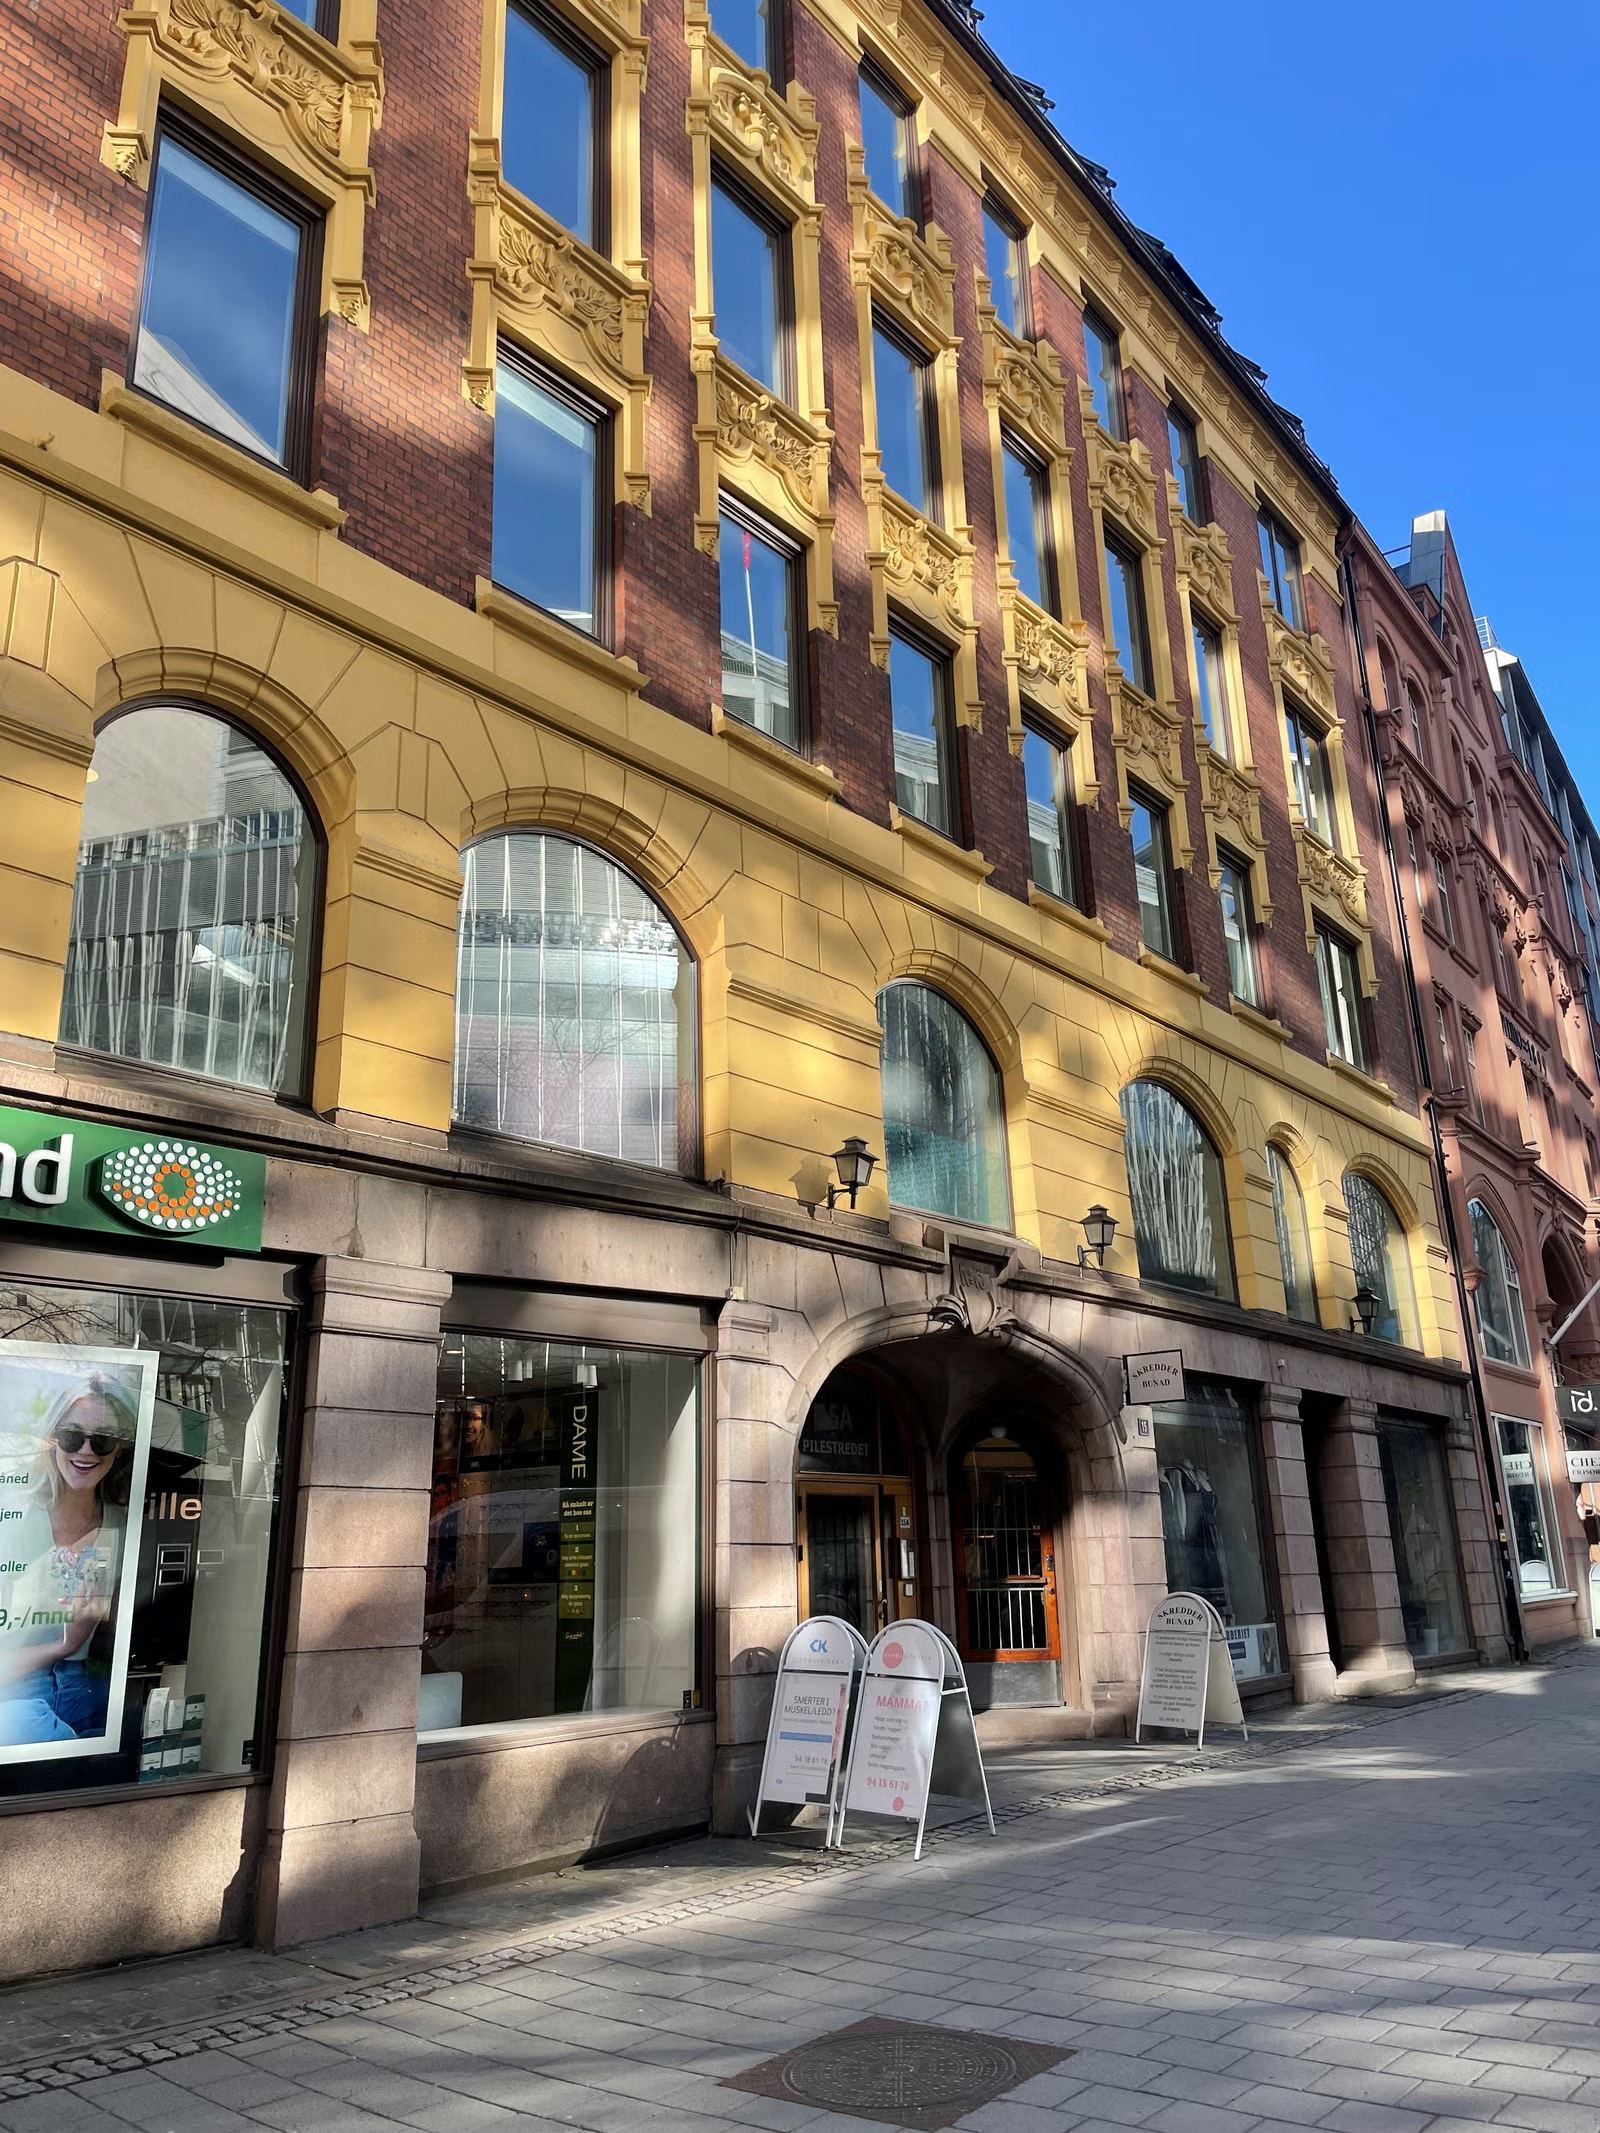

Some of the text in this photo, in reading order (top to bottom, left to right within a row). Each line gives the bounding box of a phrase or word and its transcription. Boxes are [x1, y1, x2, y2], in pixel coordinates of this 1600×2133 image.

[1132, 1363, 1179, 1379] SKREDDER
[1142, 1378, 1171, 1388] BUNAD
[1140, 1420, 1149, 1434] 15
[571, 1405, 588, 1480] DAME
[144, 1492, 202, 1520] ille
[0, 1560, 28, 1572] oller
[1157, 1607, 1204, 1622] SKREDDER
[1166, 1617, 1194, 1626] BUNAD
[809, 1639, 828, 1653] CK
[793, 1695, 826, 1707] SMERTER
[876, 1695, 928, 1711] MAMMA?
[783, 1704, 836, 1716] MUSKEL/LEDD?
[866, 1776, 877, 1787] 94
[889, 1780, 898, 1789] 61
